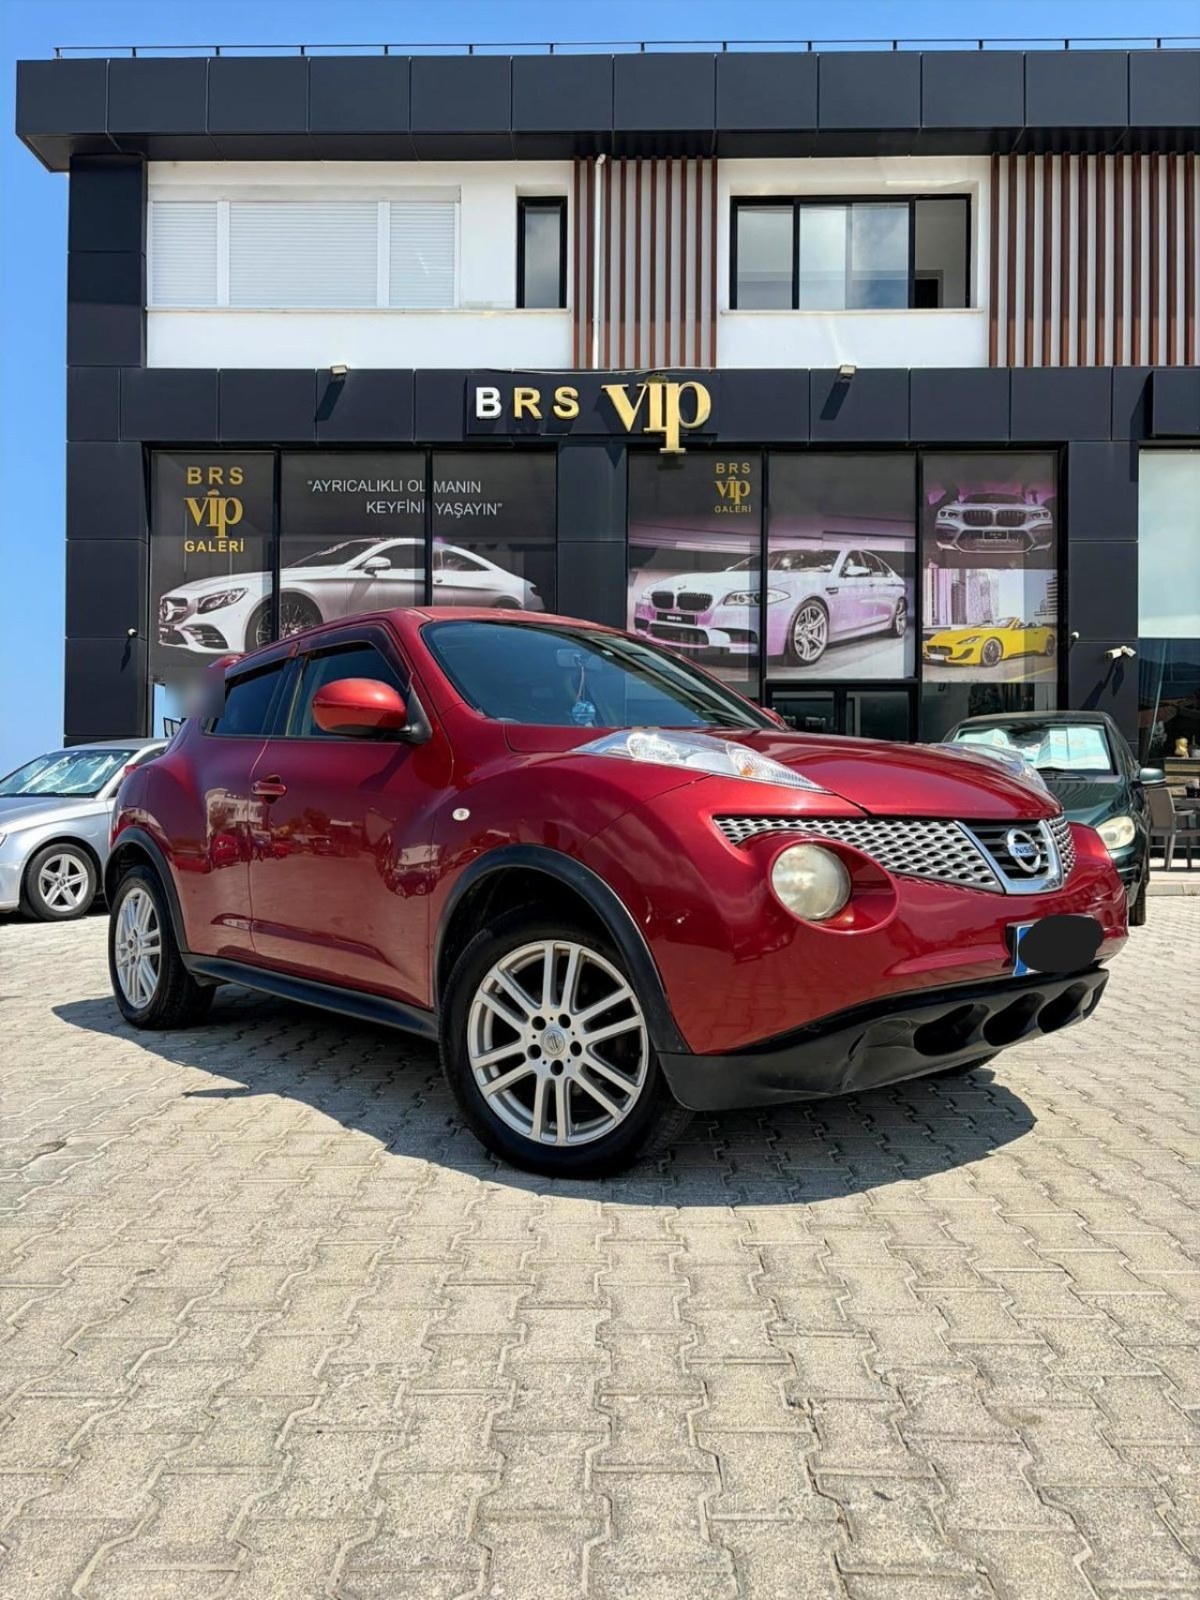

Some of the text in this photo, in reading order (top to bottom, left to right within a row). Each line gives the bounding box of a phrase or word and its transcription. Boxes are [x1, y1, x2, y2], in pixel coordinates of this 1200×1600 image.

[475, 386, 580, 419] BRS
[187, 466, 243, 485] BRS
[715, 462, 751, 474] BRS
[366, 499, 425, 514] KEYFİNİ
